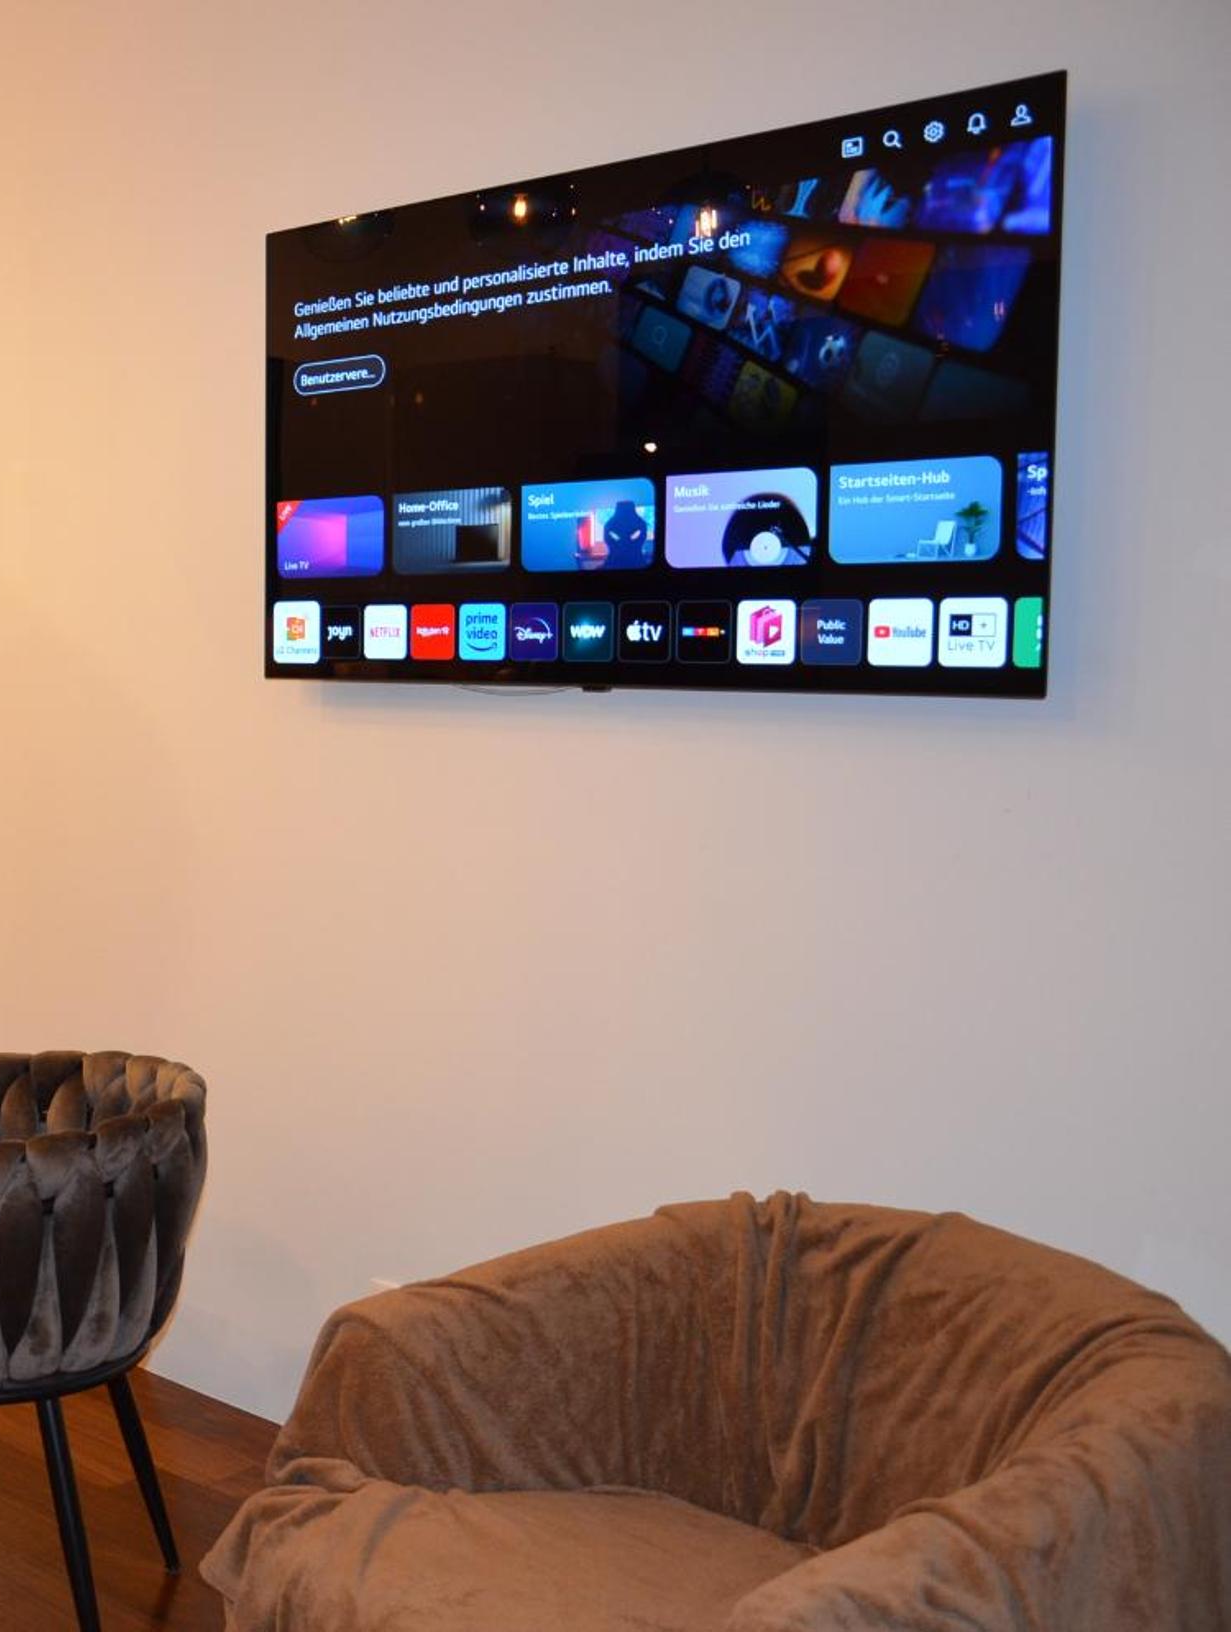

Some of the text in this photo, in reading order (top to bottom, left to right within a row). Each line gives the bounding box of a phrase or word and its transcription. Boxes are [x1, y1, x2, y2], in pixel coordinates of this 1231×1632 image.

[294, 231, 751, 318] Genießen Sie beliebte und personalisierte Inhalte, indem Sie den
[294, 278, 613, 341] Allgemeinen Nutzungsbedingungen zustimmen.
[838, 469, 951, 489] Startseiten-Hub
[1026, 464, 1047, 481] Sp
[673, 483, 710, 498] Musik
[397, 500, 459, 514] Home-Office
[527, 493, 555, 509] Spiel
[465, 611, 498, 626] prime
[816, 618, 847, 631] Public
[950, 619, 970, 632] HD
[369, 626, 400, 638] NETFLIX
[465, 625, 499, 640] video
[817, 633, 845, 645] Value
[947, 639, 996, 652] Live TV
